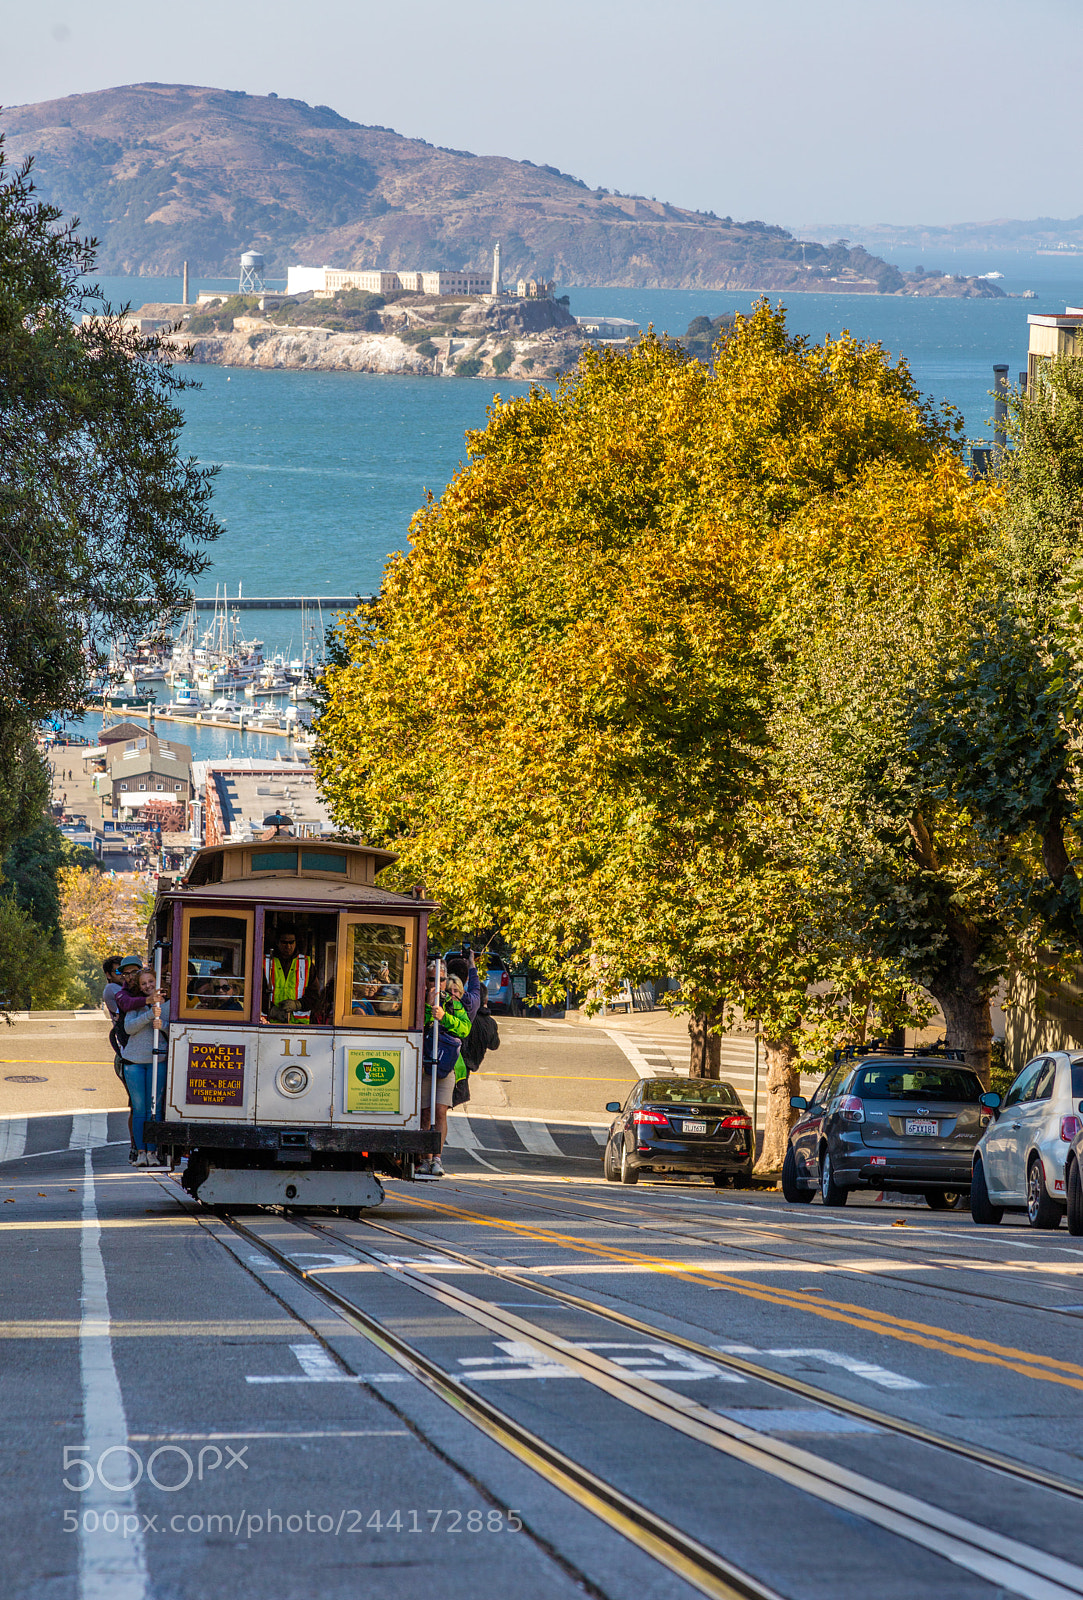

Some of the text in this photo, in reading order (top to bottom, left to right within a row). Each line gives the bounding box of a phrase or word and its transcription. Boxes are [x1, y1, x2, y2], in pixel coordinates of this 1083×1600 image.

[192, 1046, 243, 1056] POWELL
[280, 1039, 311, 1057] 11
[191, 1060, 243, 1069] MARKET
[189, 1078, 207, 1088] HYDE
[218, 1079, 241, 1089] BEACH
[193, 1089, 236, 1097] FISHERMANS
